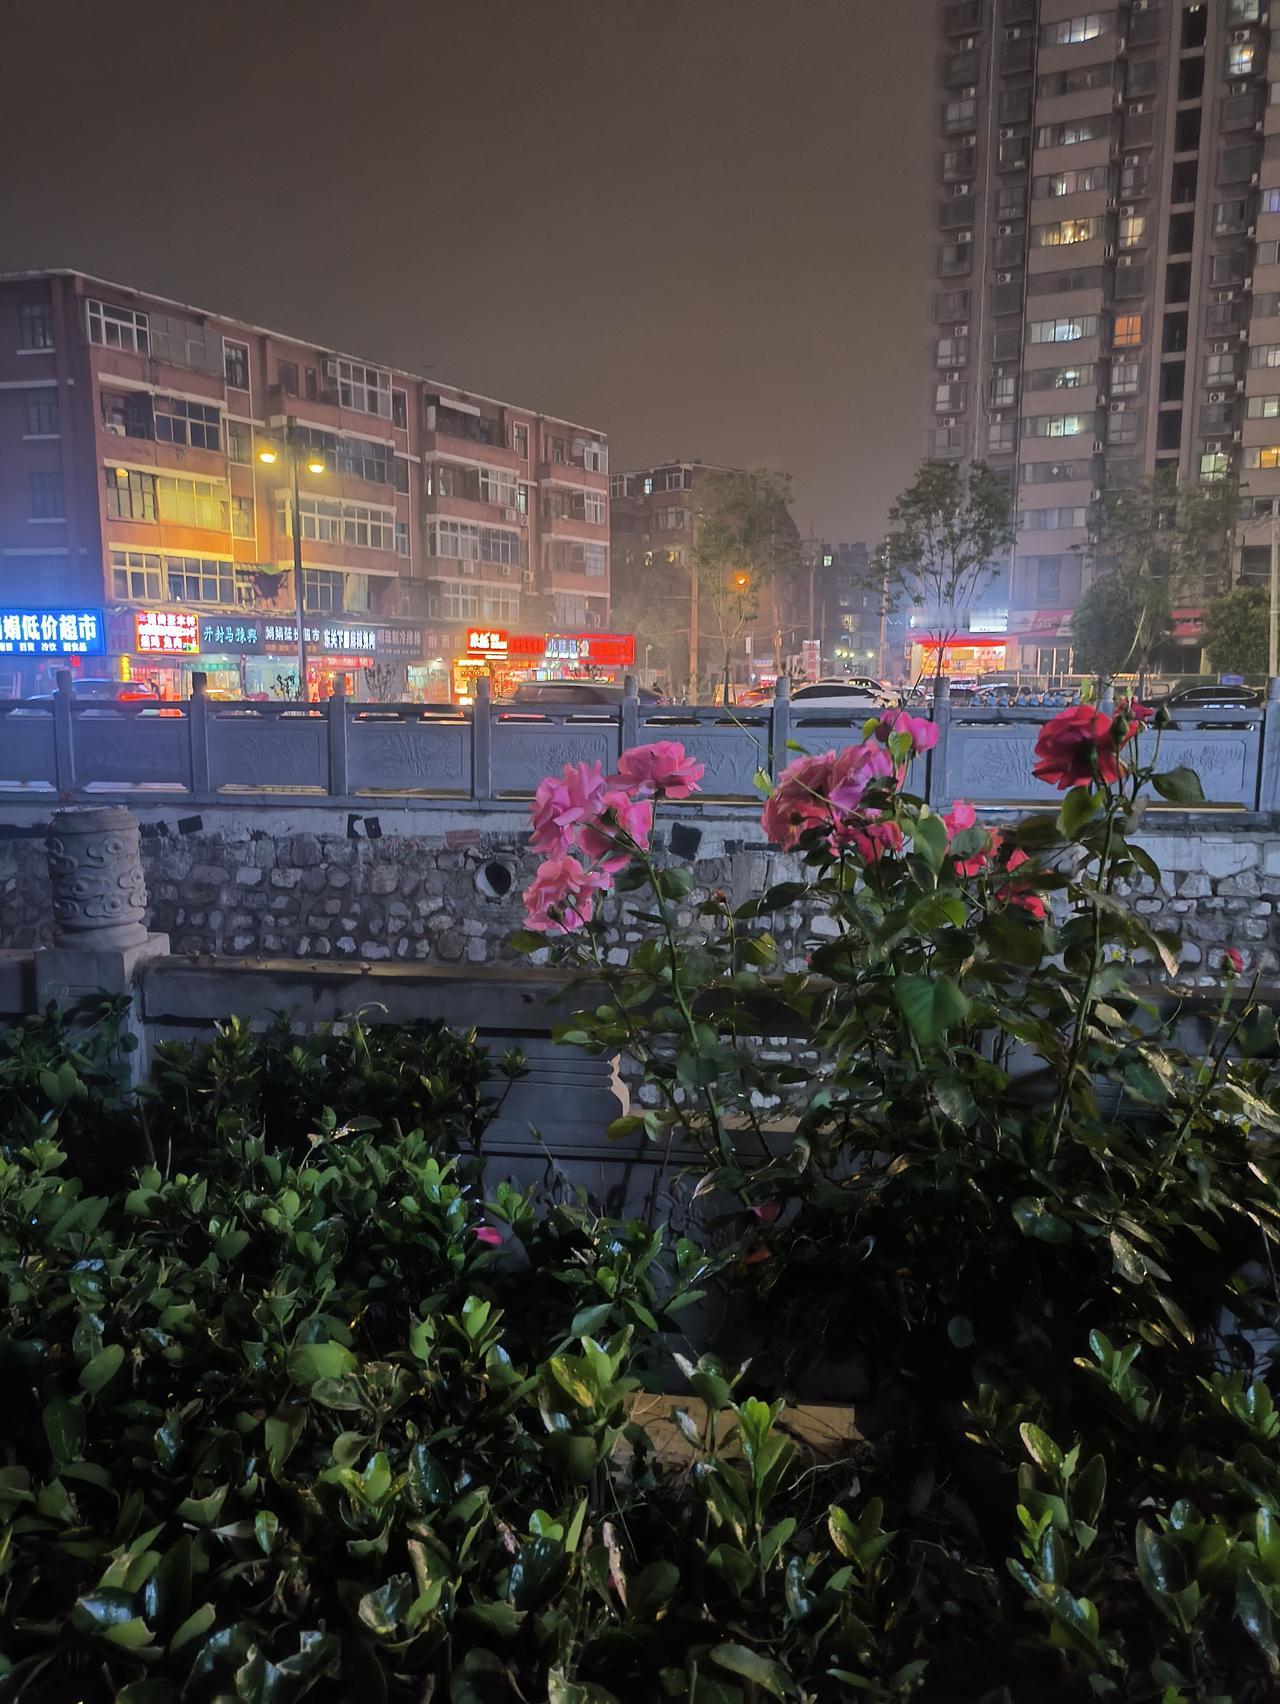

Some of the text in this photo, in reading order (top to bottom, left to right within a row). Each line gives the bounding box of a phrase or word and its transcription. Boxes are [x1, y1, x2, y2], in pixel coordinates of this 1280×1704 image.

[0, 614, 96, 641] 娟低价超市
